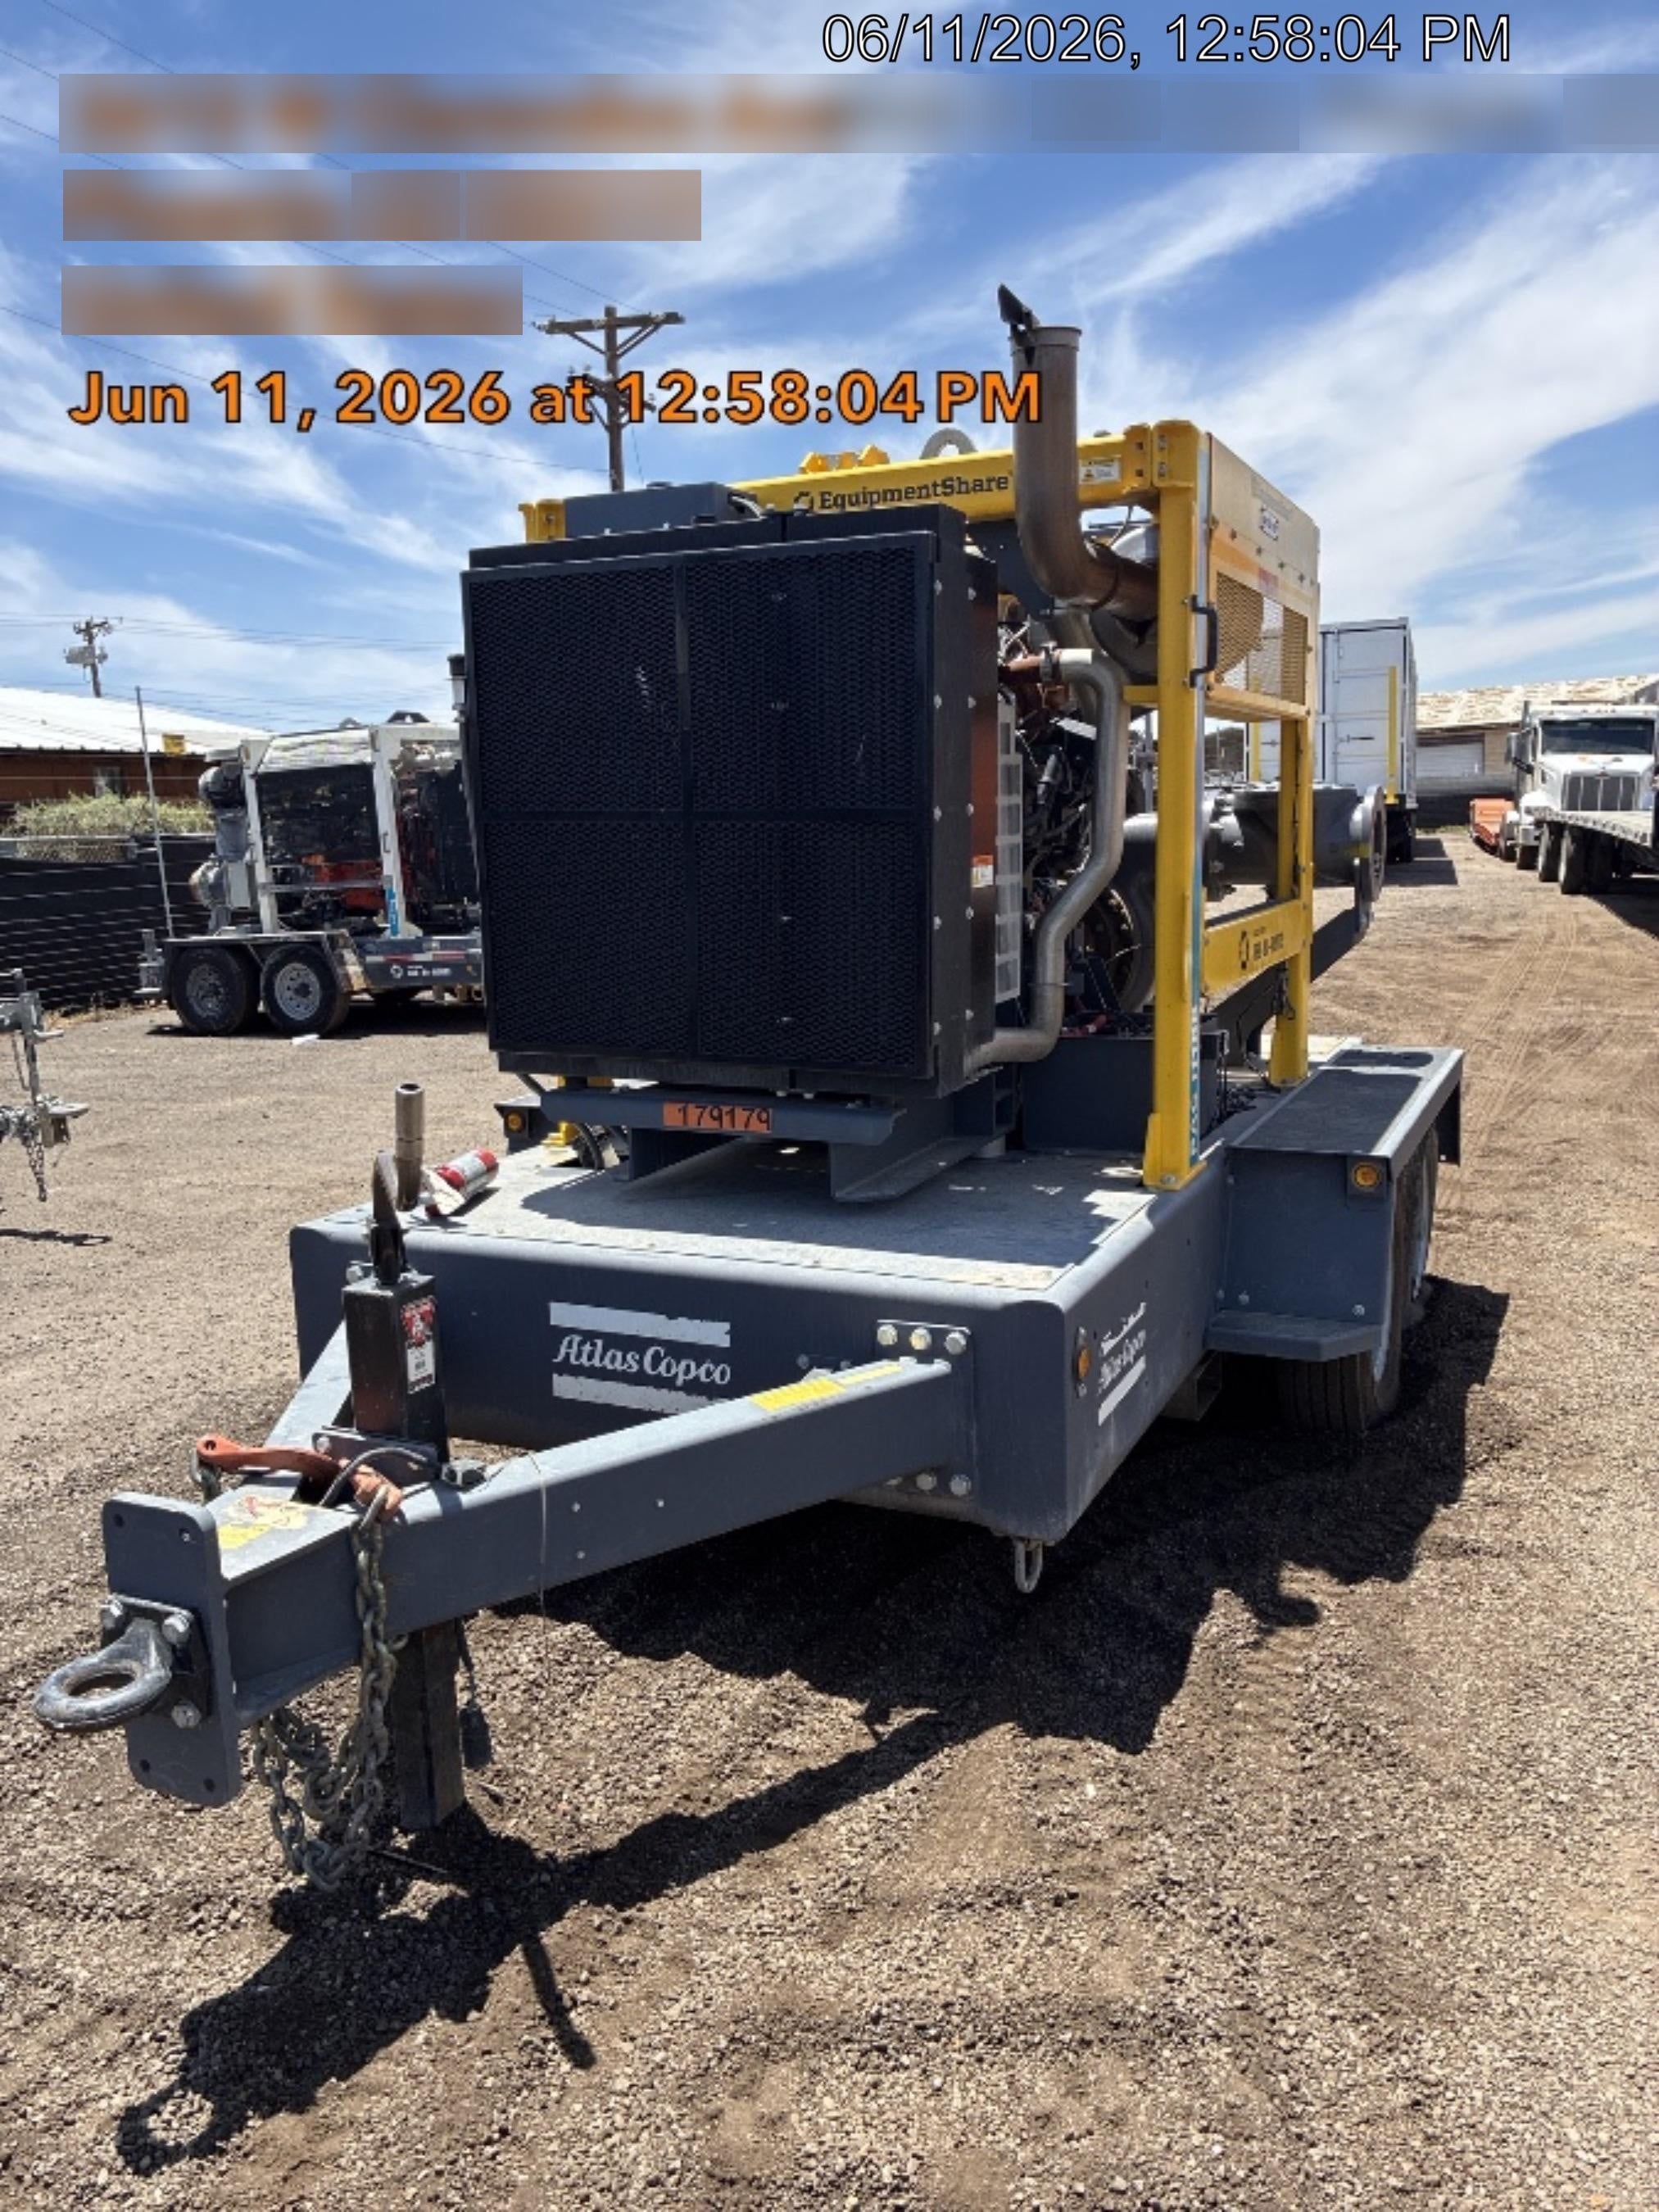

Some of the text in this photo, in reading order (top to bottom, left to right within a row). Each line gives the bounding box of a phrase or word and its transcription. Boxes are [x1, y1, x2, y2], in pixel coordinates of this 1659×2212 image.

[819, 475, 1009, 510] EquipmentShare
[677, 1104, 771, 1131] 179179
[552, 1333, 731, 1388] Atlas Copco
